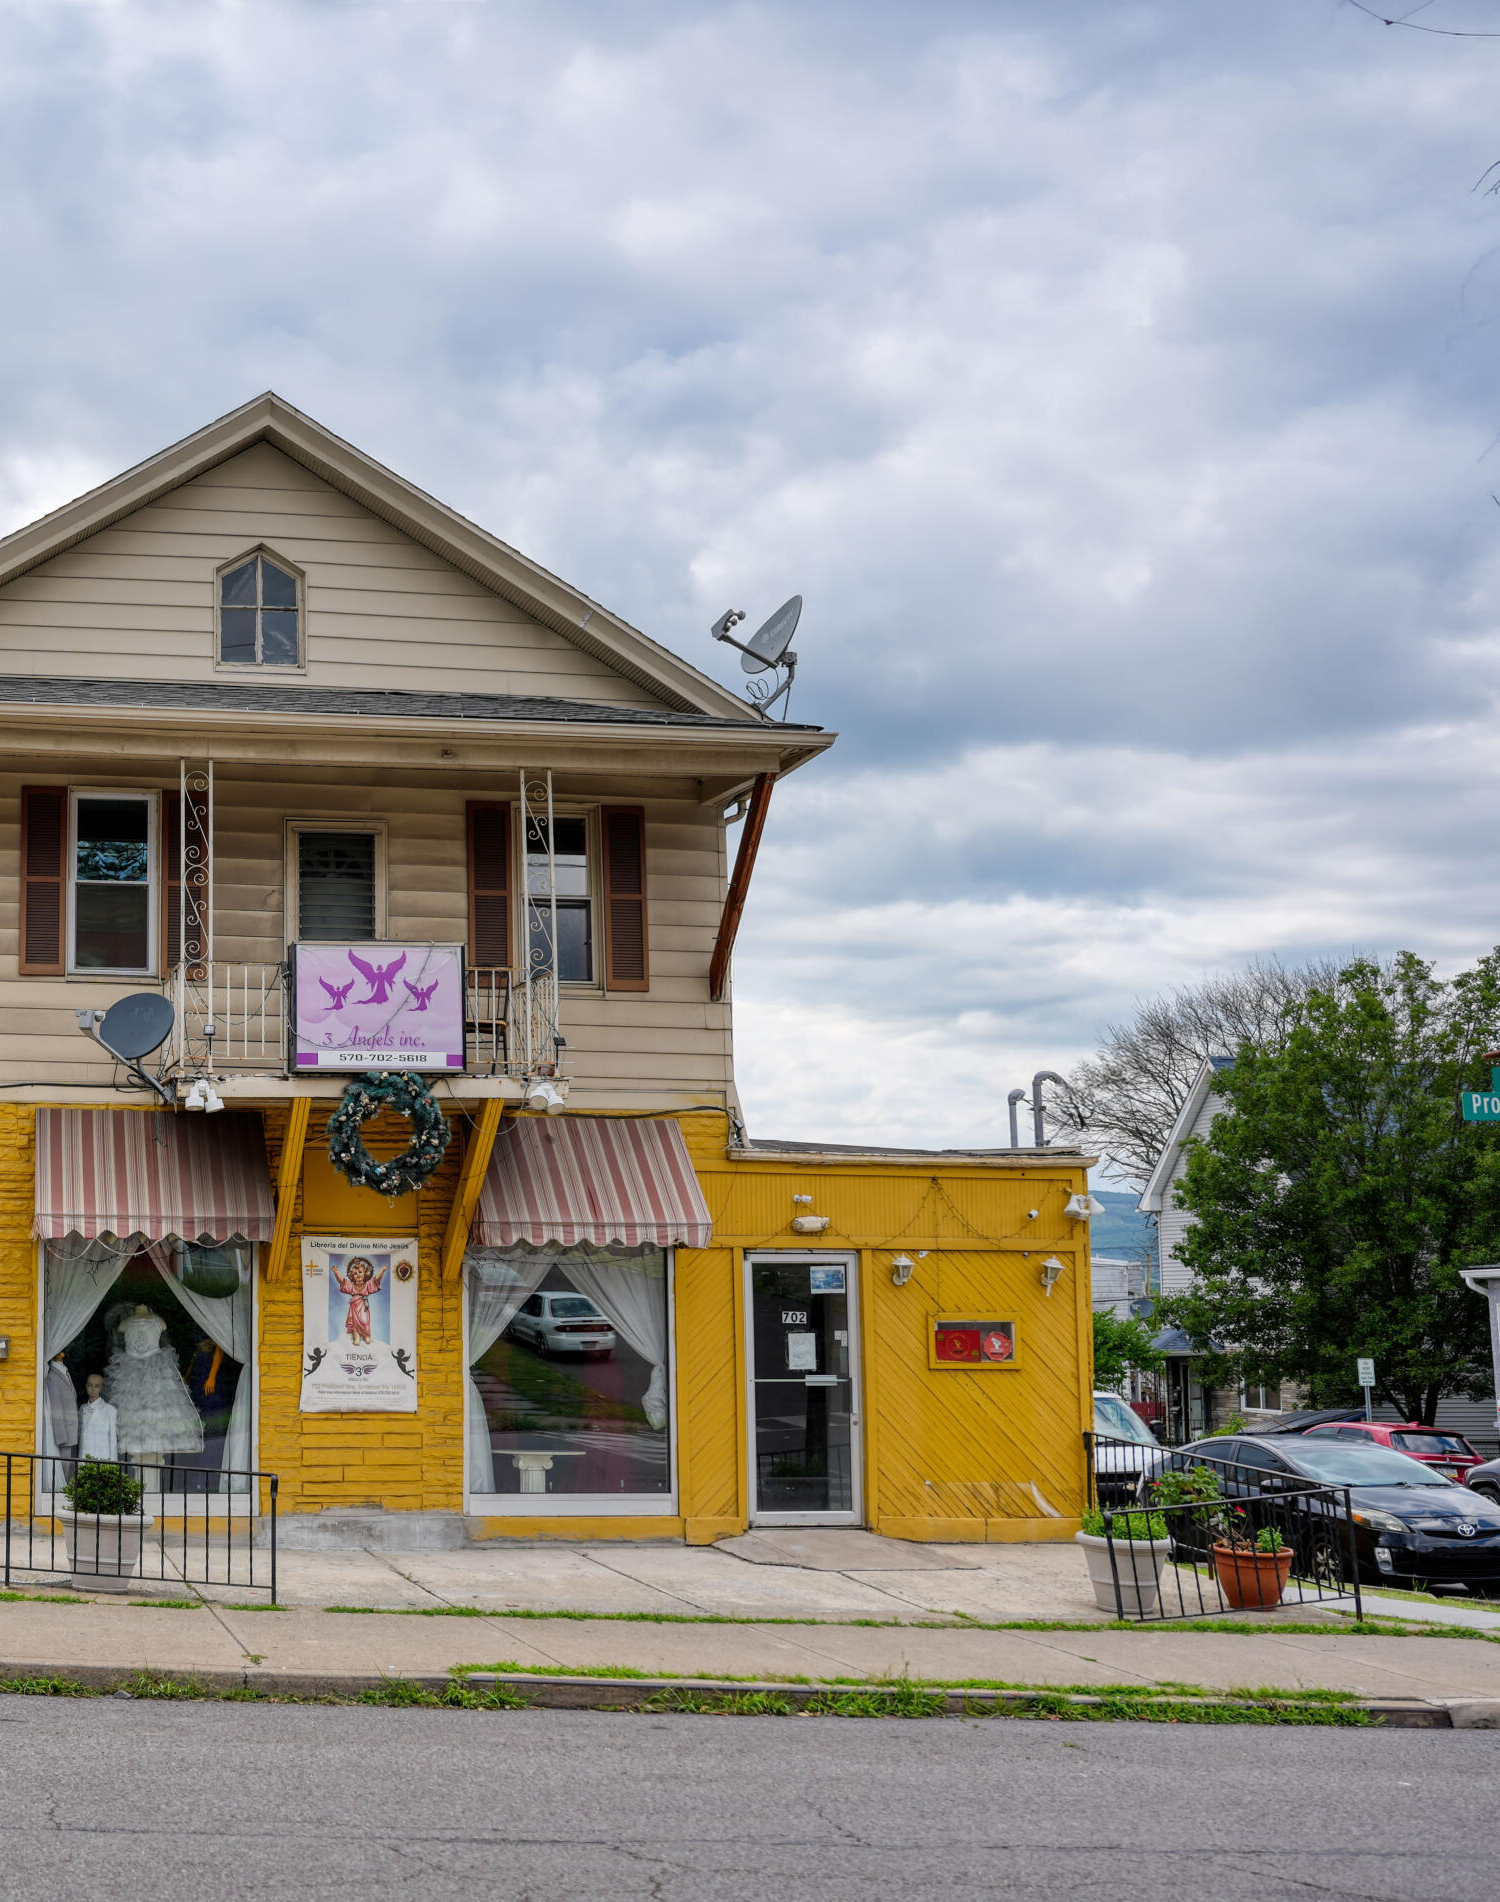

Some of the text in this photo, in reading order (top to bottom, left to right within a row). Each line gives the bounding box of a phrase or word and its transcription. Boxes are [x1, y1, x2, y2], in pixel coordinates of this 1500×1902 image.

[322, 1025, 426, 1051] 3 Angels inc.
[339, 1053, 427, 1062] 570-702-5618
[1472, 1094, 1500, 1114] Pro
[783, 1312, 806, 1323] 702
[345, 1353, 373, 1361] TIENDA
[355, 1367, 362, 1377] 3
